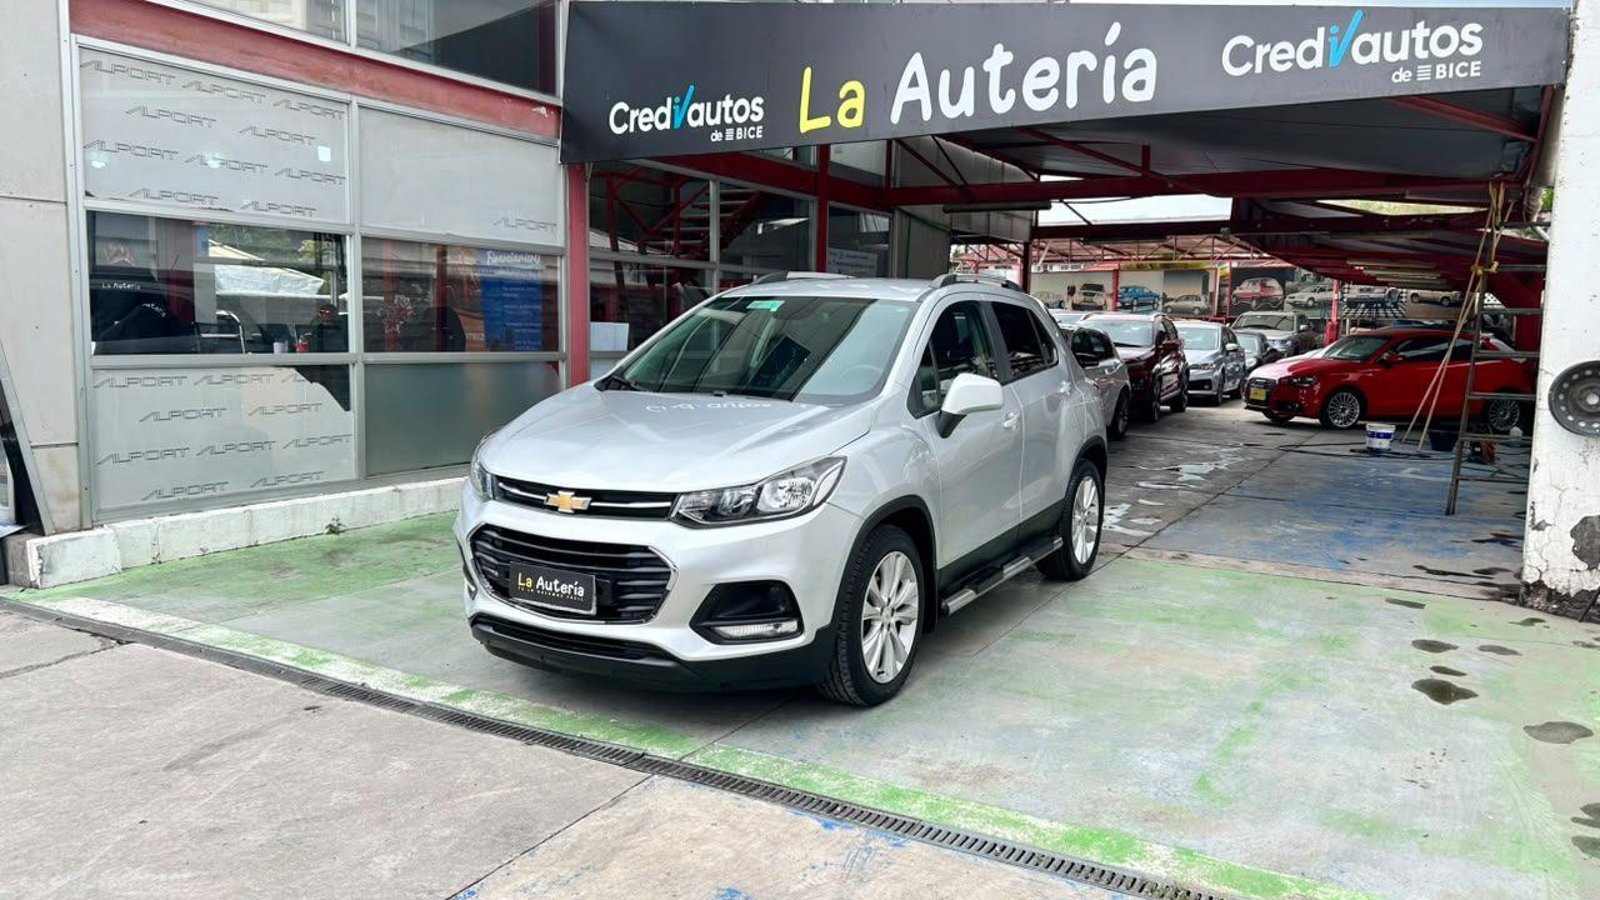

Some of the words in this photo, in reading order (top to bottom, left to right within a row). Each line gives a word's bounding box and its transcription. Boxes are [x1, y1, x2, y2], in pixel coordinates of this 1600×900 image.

[799, 66, 865, 134] La
[890, 21, 1157, 125] Autería
[1391, 67, 1412, 83] de
[1435, 61, 1482, 80] BICE
[80, 60, 176, 85] ALPORT
[182, 80, 266, 104] ALPORT
[273, 99, 345, 120] ALPORT
[125, 105, 217, 128] ALPORT
[240, 126, 316, 146] ALPORT
[710, 129, 724, 142] de
[736, 125, 763, 140] BICE
[83, 139, 178, 161] ALPORT
[275, 168, 346, 186] ALPORT
[129, 188, 219, 206] ALPORT
[241, 200, 317, 218] ALPORT
[93, 375, 188, 389] ALPORT
[193, 373, 275, 387] ALPORT
[139, 406, 228, 423] ALPORT
[248, 402, 323, 417] ALPORT
[97, 446, 190, 466] ALPORT
[196, 440, 276, 456] ALPORT
[282, 433, 352, 450] ALPORT
[142, 481, 229, 501] ALPORT
[250, 470, 324, 488] ALPORT
[518, 572, 532, 588] La
[536, 576, 585, 597] Autería
